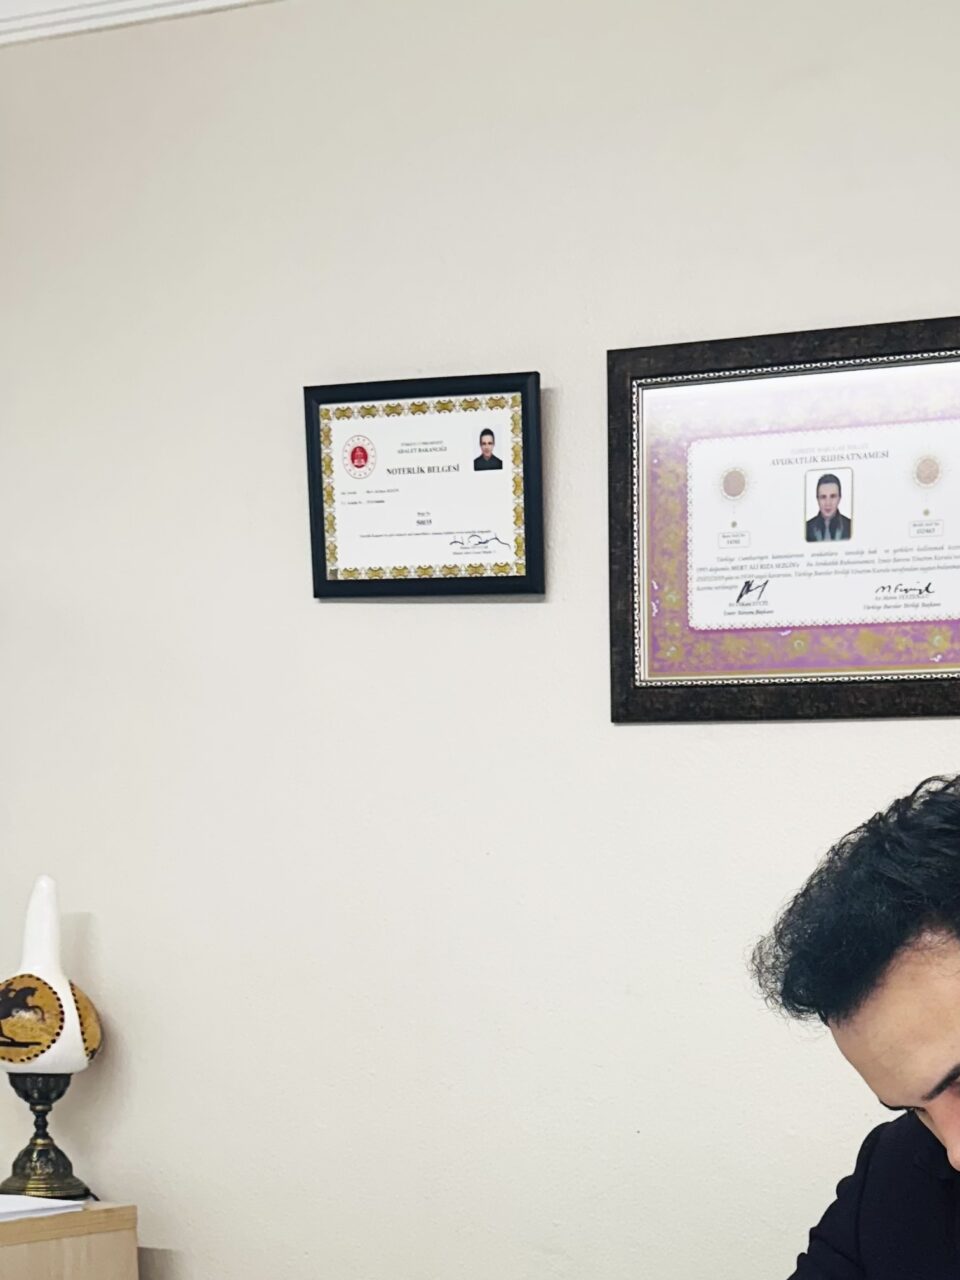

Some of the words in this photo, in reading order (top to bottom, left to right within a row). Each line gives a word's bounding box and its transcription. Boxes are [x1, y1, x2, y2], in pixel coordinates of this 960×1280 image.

[769, 455, 819, 467] AVUKATLIK
[386, 466, 426, 475] NOTERLİK
[427, 463, 460, 474] BELGESİ
